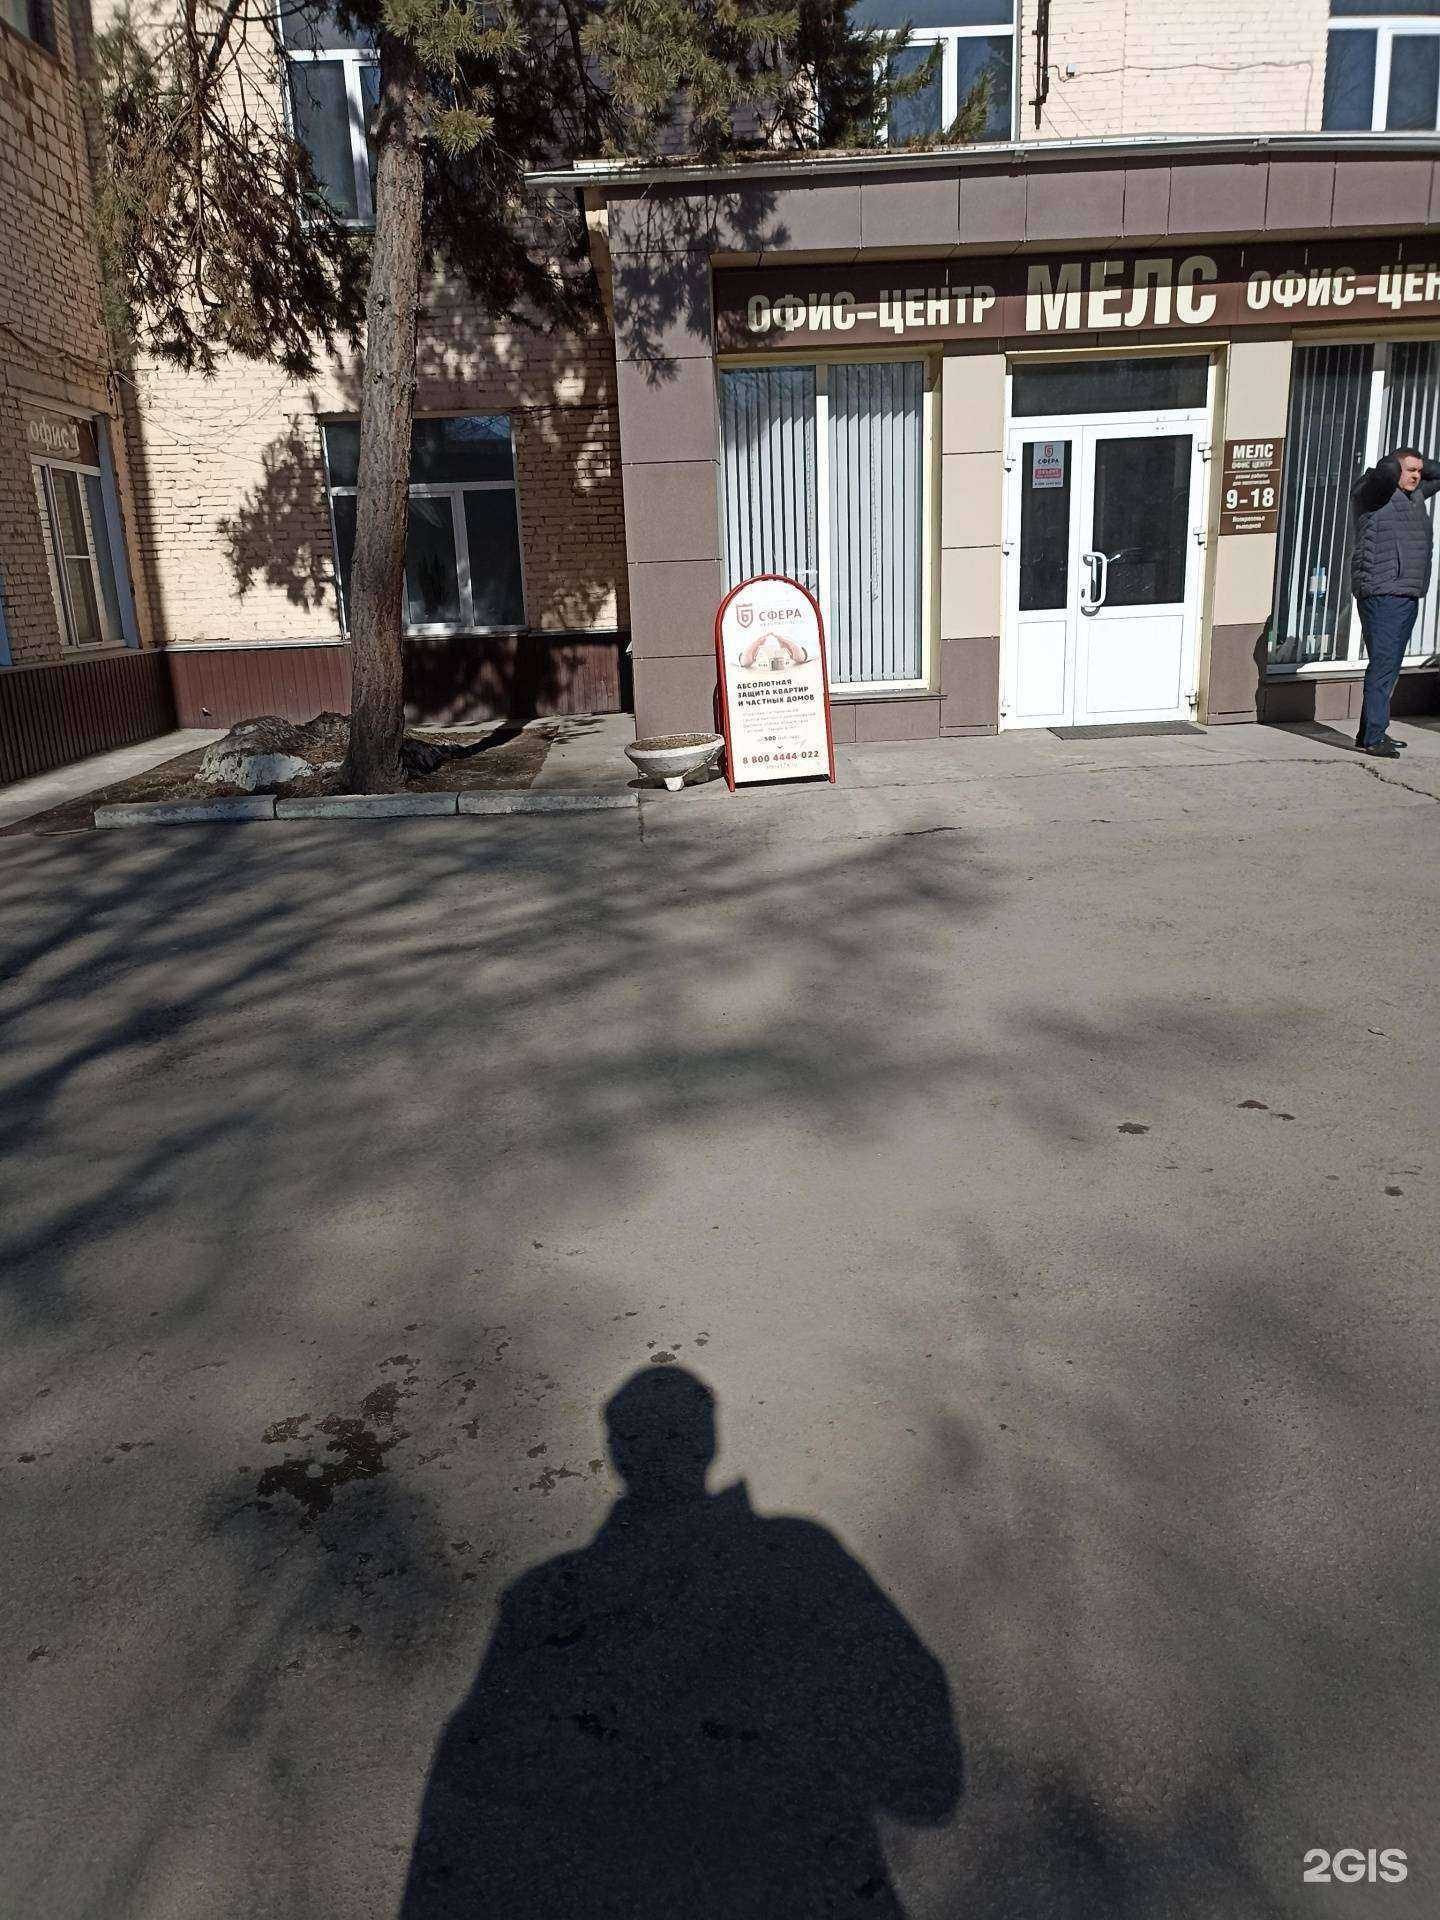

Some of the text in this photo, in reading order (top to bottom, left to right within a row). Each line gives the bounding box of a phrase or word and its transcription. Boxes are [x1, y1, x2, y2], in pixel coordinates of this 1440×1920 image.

[747, 285, 996, 334] ОФИС-ЦЕНТР
[1025, 255, 1217, 331] МЕЛС
[1232, 443, 1274, 460] МЕЛС
[759, 608, 802, 621] СФЕРА
[736, 679, 793, 690] АБСОЛЮТНАЯ
[737, 686, 809, 699] ЗАЩИТА КВАРТИР
[745, 697, 784, 706] ЧАСТНЫХ
[786, 694, 815, 703] ДОМОВ
[751, 754, 770, 764] 800
[801, 750, 820, 759] 022
